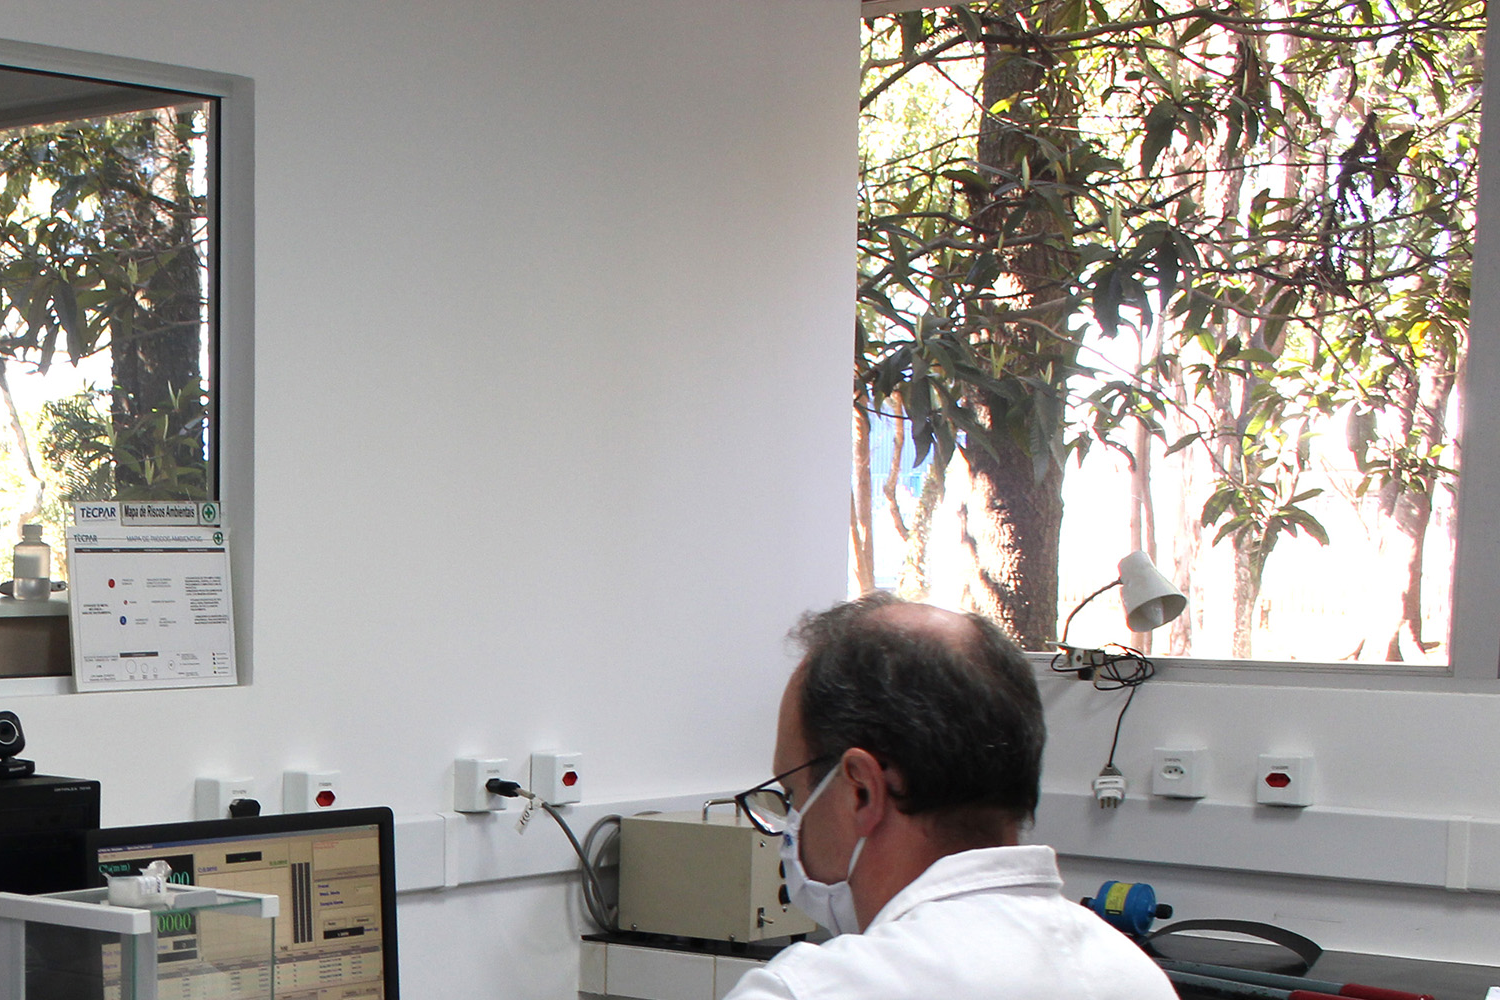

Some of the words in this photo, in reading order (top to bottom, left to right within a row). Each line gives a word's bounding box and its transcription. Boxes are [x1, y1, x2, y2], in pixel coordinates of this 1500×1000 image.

[124, 505, 138, 520] Mapa
[140, 504, 146, 517] de
[147, 504, 165, 519] Riscos
[166, 505, 195, 519] Ambientais
